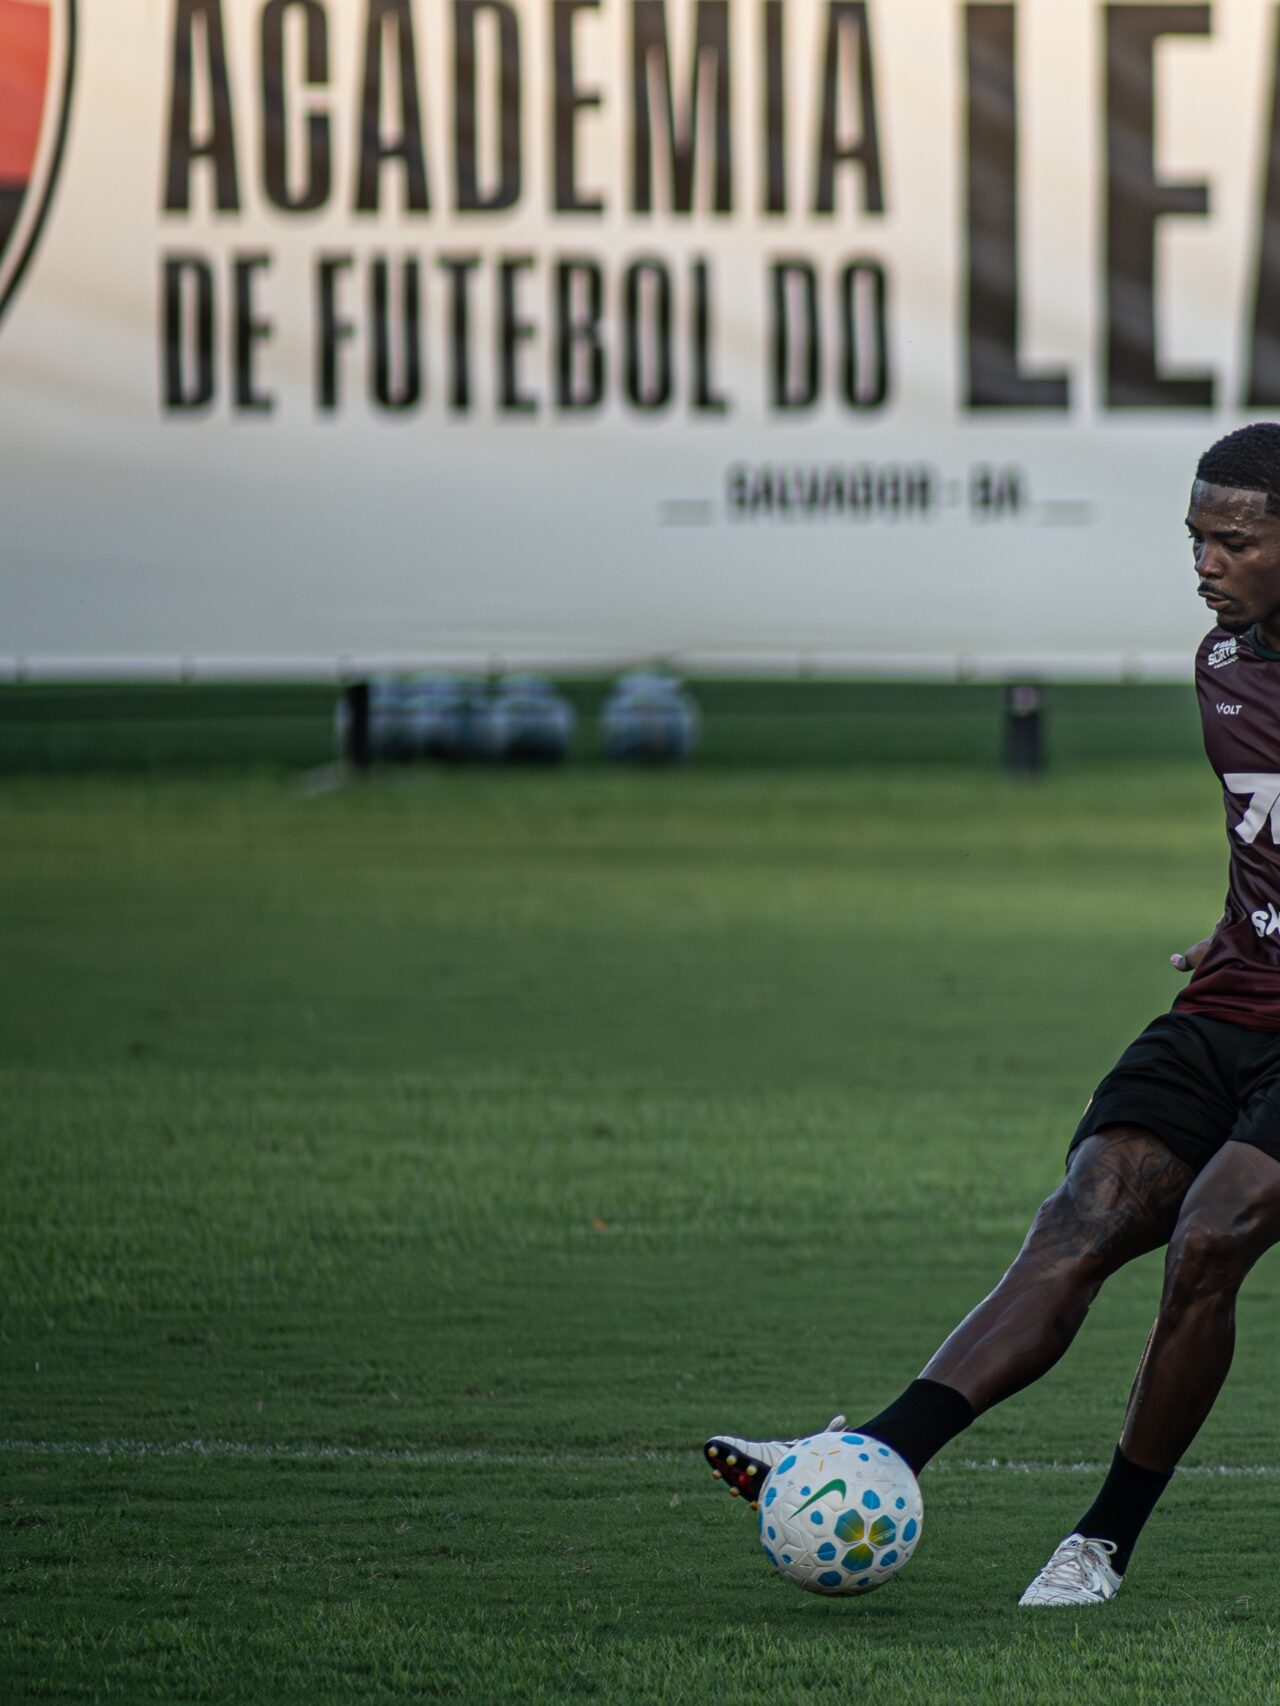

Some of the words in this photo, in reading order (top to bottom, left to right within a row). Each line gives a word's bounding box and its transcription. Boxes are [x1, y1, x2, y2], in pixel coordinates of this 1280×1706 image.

[162, 0, 885, 213] ACADEMIA
[161, 252, 274, 413] DE
[314, 252, 729, 413] FUTEBOL
[770, 256, 889, 413] DO
[727, 463, 937, 522] SALVADOR
[1208, 646, 1241, 666] SORTE
[1215, 702, 1243, 715] VOLT
